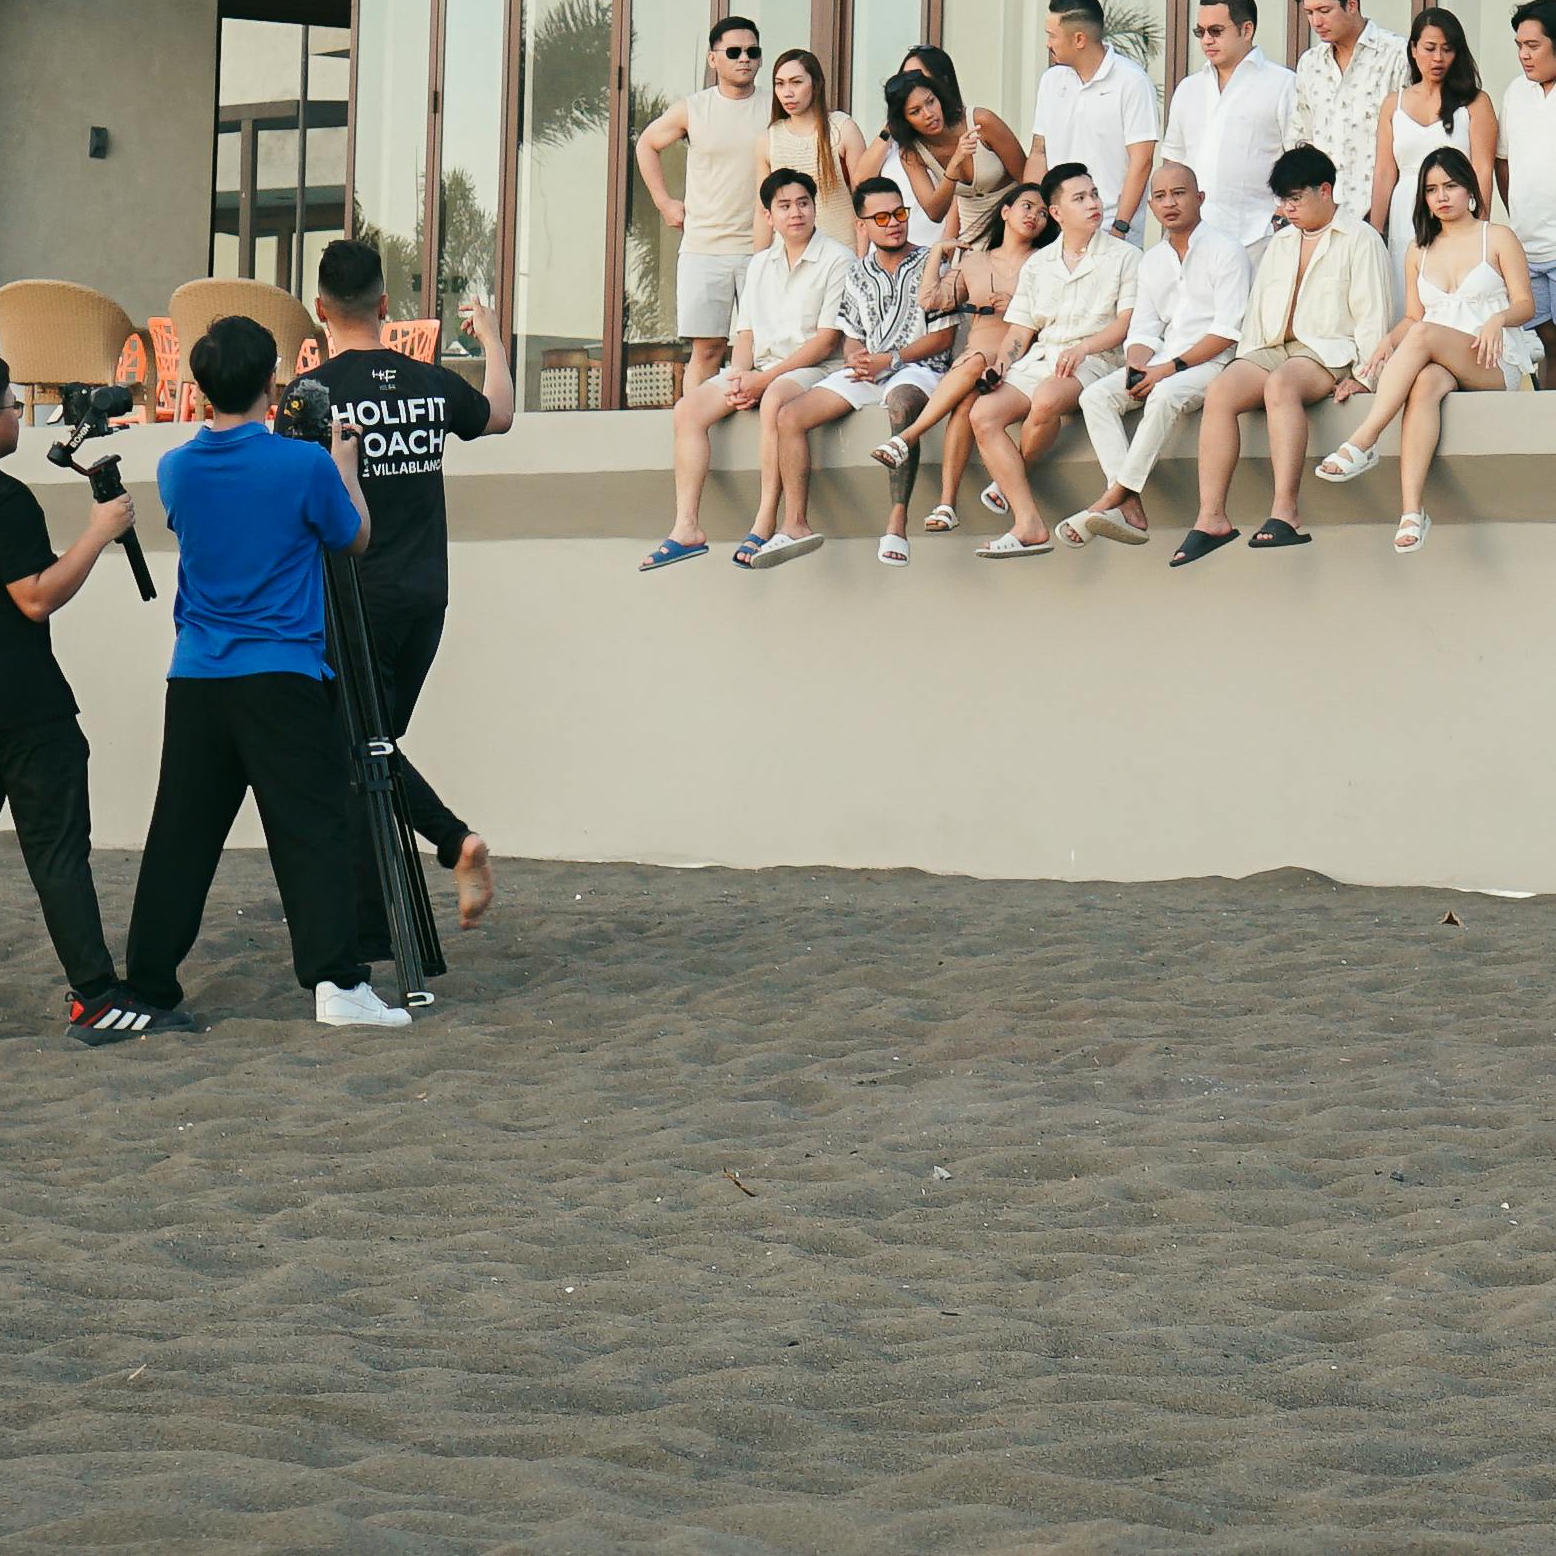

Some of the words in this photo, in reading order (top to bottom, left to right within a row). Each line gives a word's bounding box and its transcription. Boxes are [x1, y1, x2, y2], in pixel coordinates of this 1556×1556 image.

[330, 397, 446, 426] HOLIFIT
[363, 428, 444, 458] OACH
[372, 458, 442, 477] VILLABLANC
